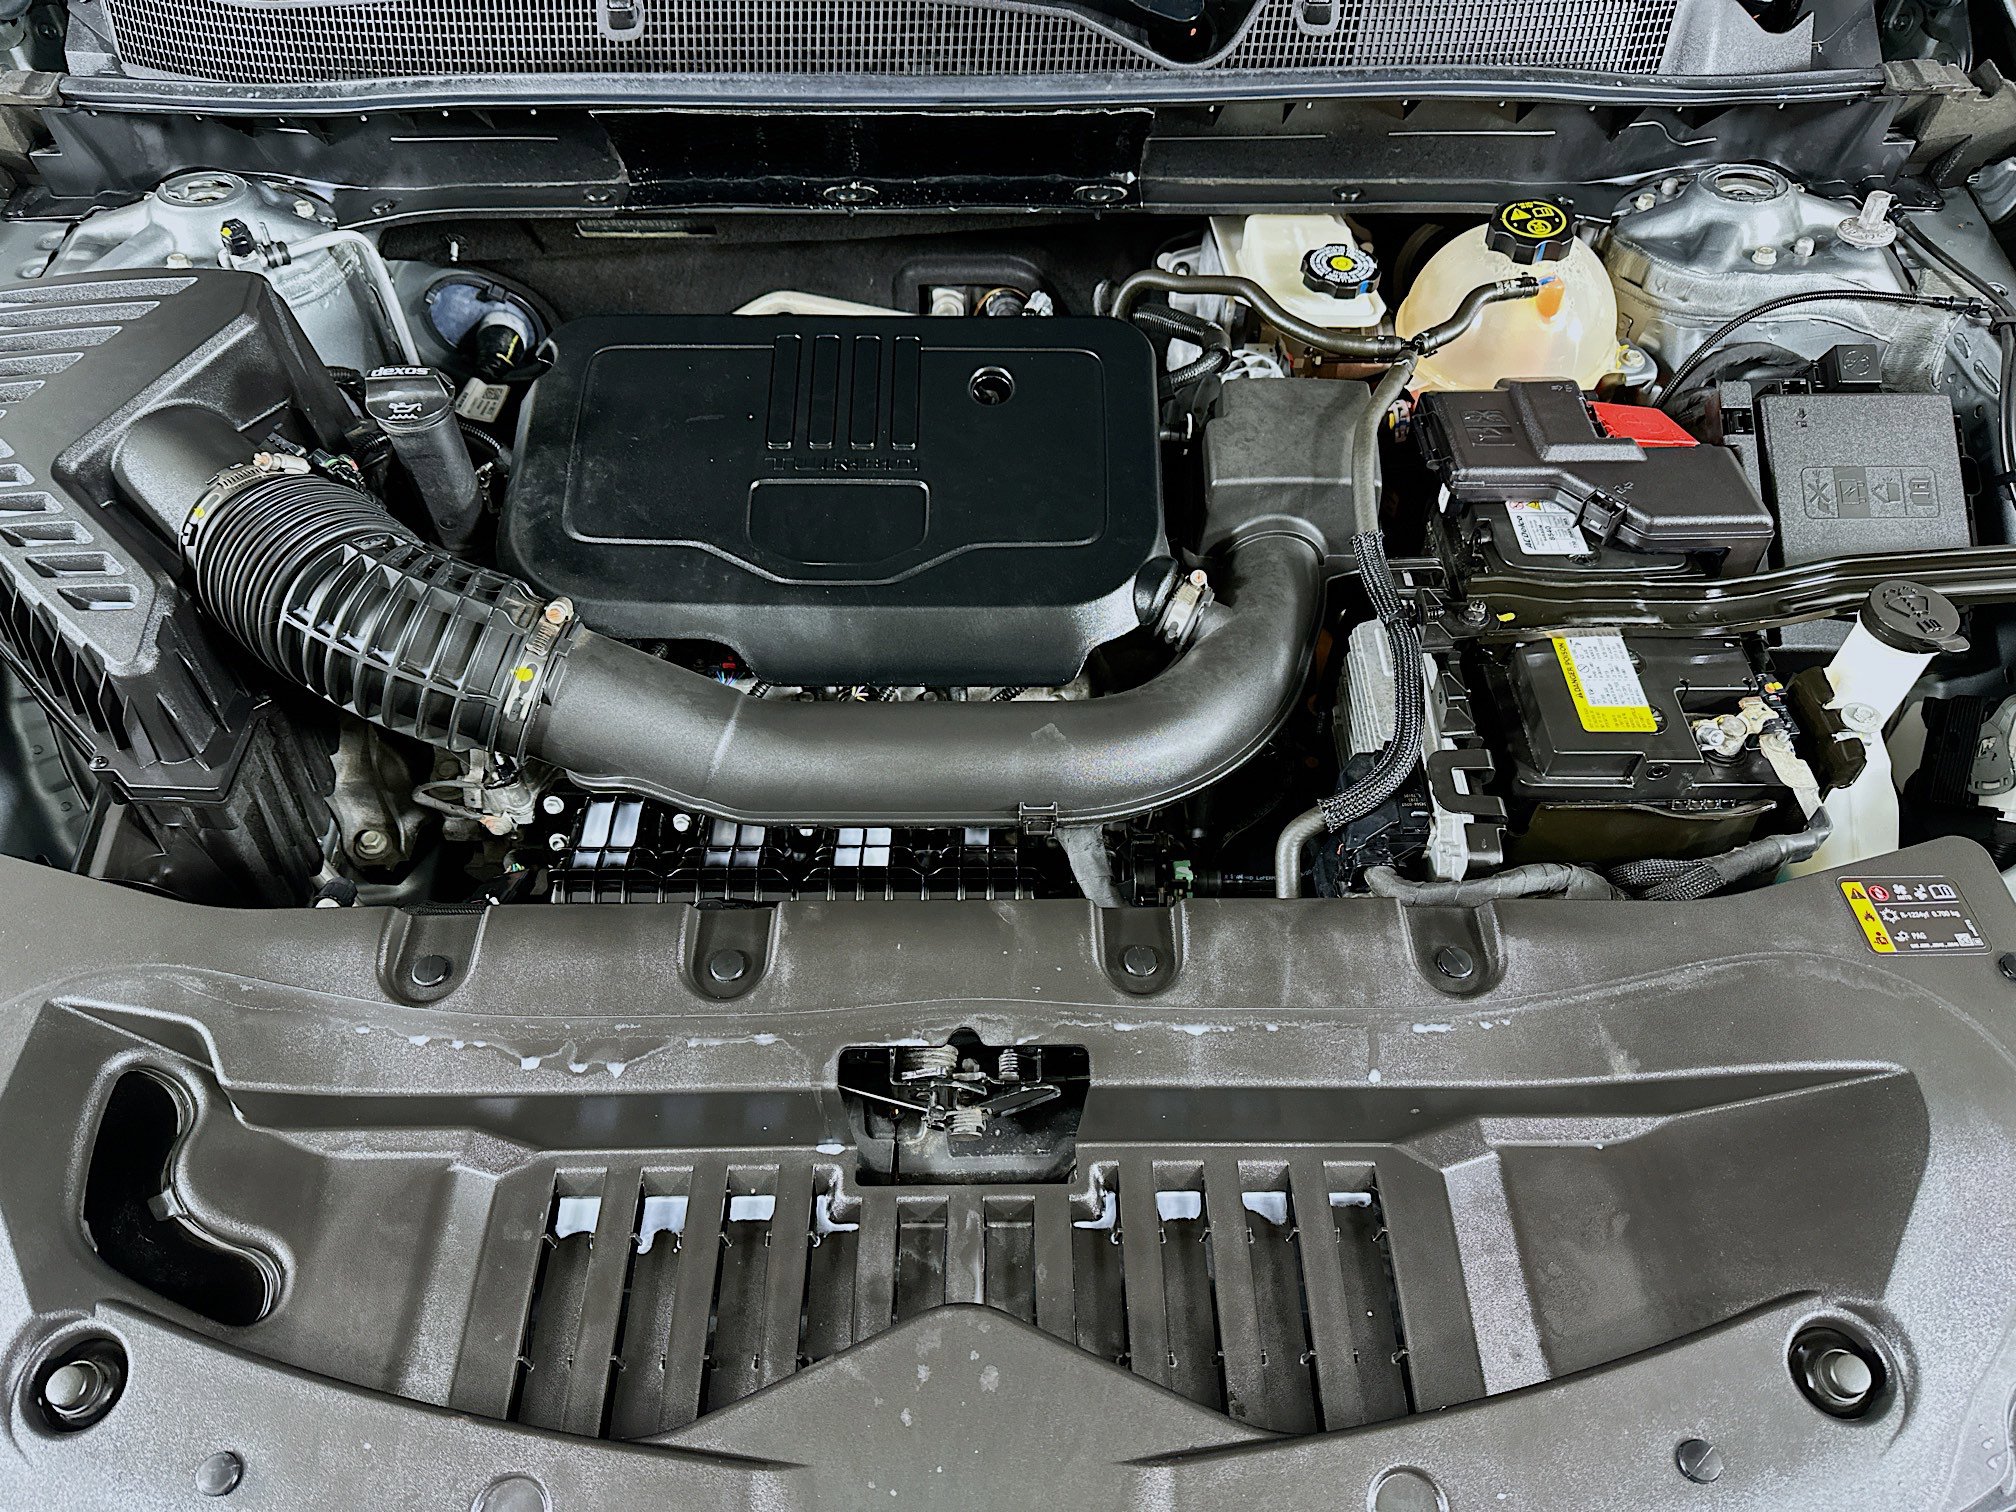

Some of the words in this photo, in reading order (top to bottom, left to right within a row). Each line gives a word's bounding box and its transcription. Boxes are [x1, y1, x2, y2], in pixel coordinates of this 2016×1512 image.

[370, 366, 430, 377] dexos
[764, 457, 919, 471] TURBO
[1558, 642, 1571, 666] POISON
[1566, 667, 1581, 693] DANGER
[1911, 932, 1927, 940] PAG
